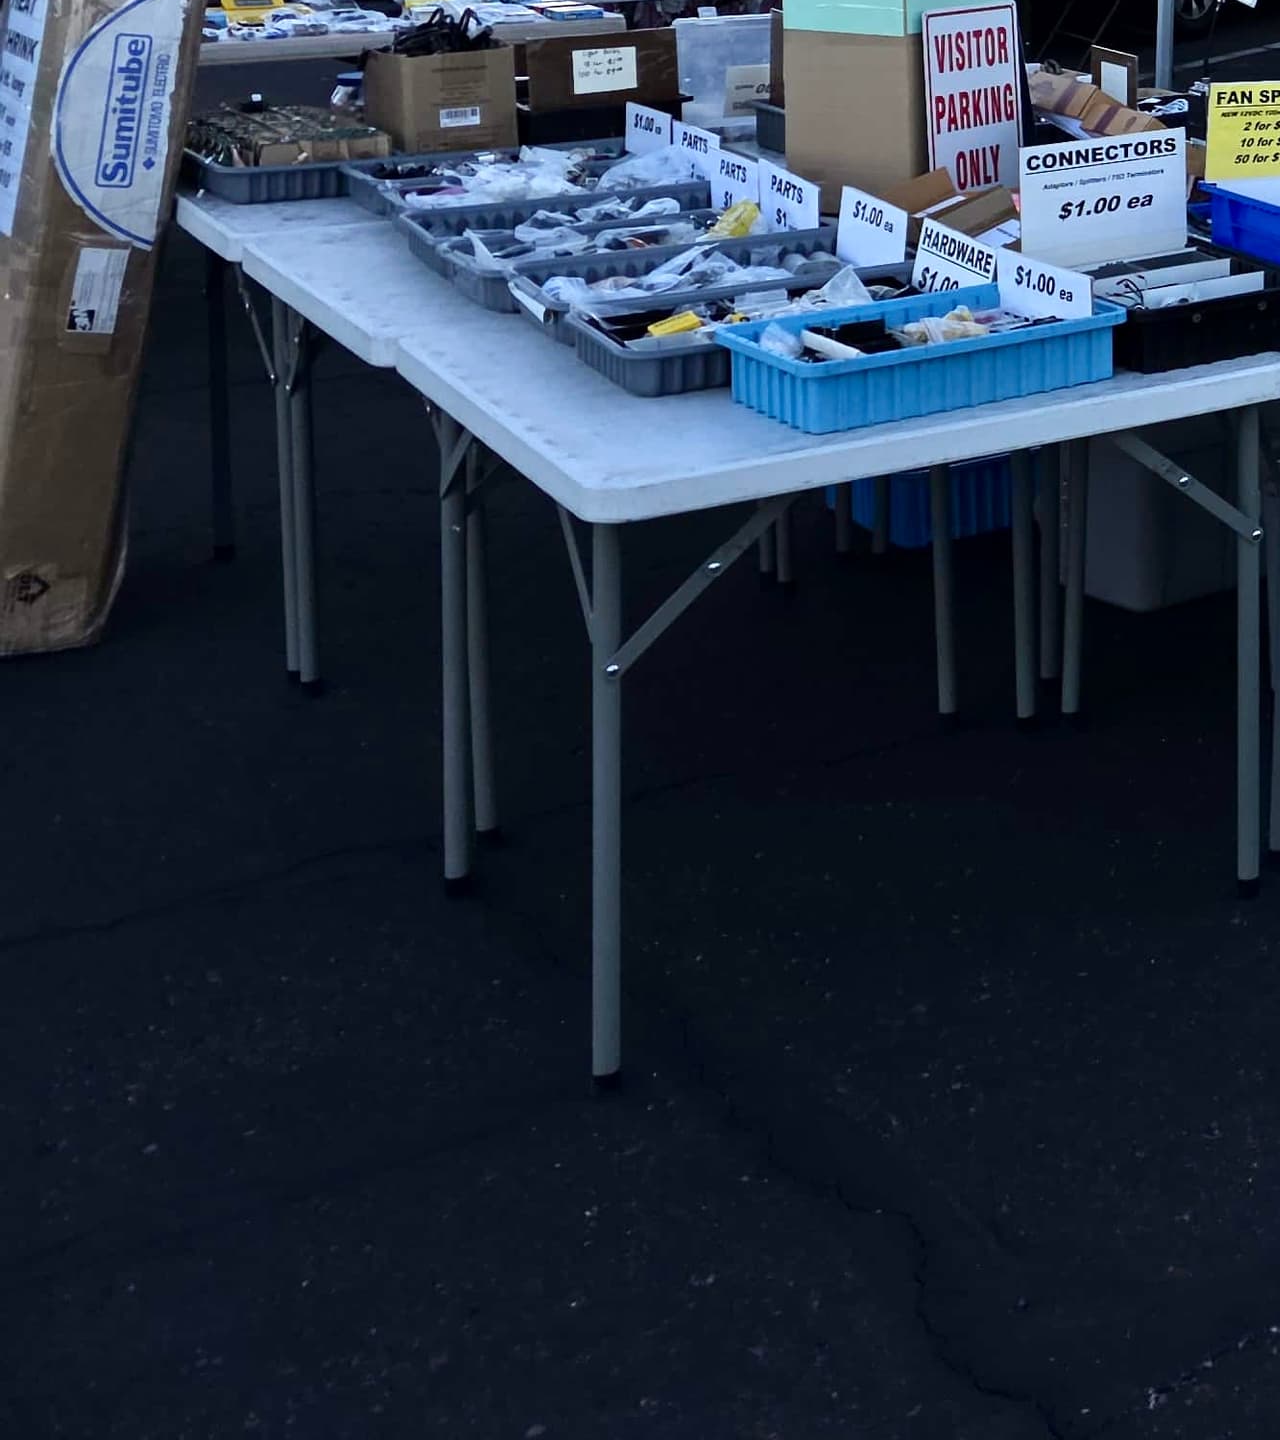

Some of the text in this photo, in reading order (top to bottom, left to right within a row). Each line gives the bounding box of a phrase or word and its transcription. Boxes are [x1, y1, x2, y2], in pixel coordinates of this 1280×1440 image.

[7, 31, 39, 64] HRINK
[934, 26, 1008, 74] VISITOR
[103, 38, 146, 183] Sumitube
[934, 83, 1014, 135] PARKING
[1217, 90, 1253, 105] FAN
[634, 113, 655, 133] $1.00
[1243, 122, 1252, 131] 2
[1254, 121, 1271, 131] for
[681, 131, 708, 154] PARTS
[1026, 137, 1177, 171] CONNECTORS
[1240, 138, 1254, 147] 10
[1257, 137, 1273, 146] for
[720, 159, 747, 183] PARTS
[956, 144, 1000, 191] ONLY
[1234, 154, 1250, 164] 50
[1253, 153, 1269, 163] for
[770, 175, 803, 204] PARTS
[853, 201, 894, 233] $1.00 ea
[1058, 194, 1154, 222] $1.00 ea
[922, 227, 993, 274] HARDWARE
[1015, 265, 1073, 302] $1.00 ea
